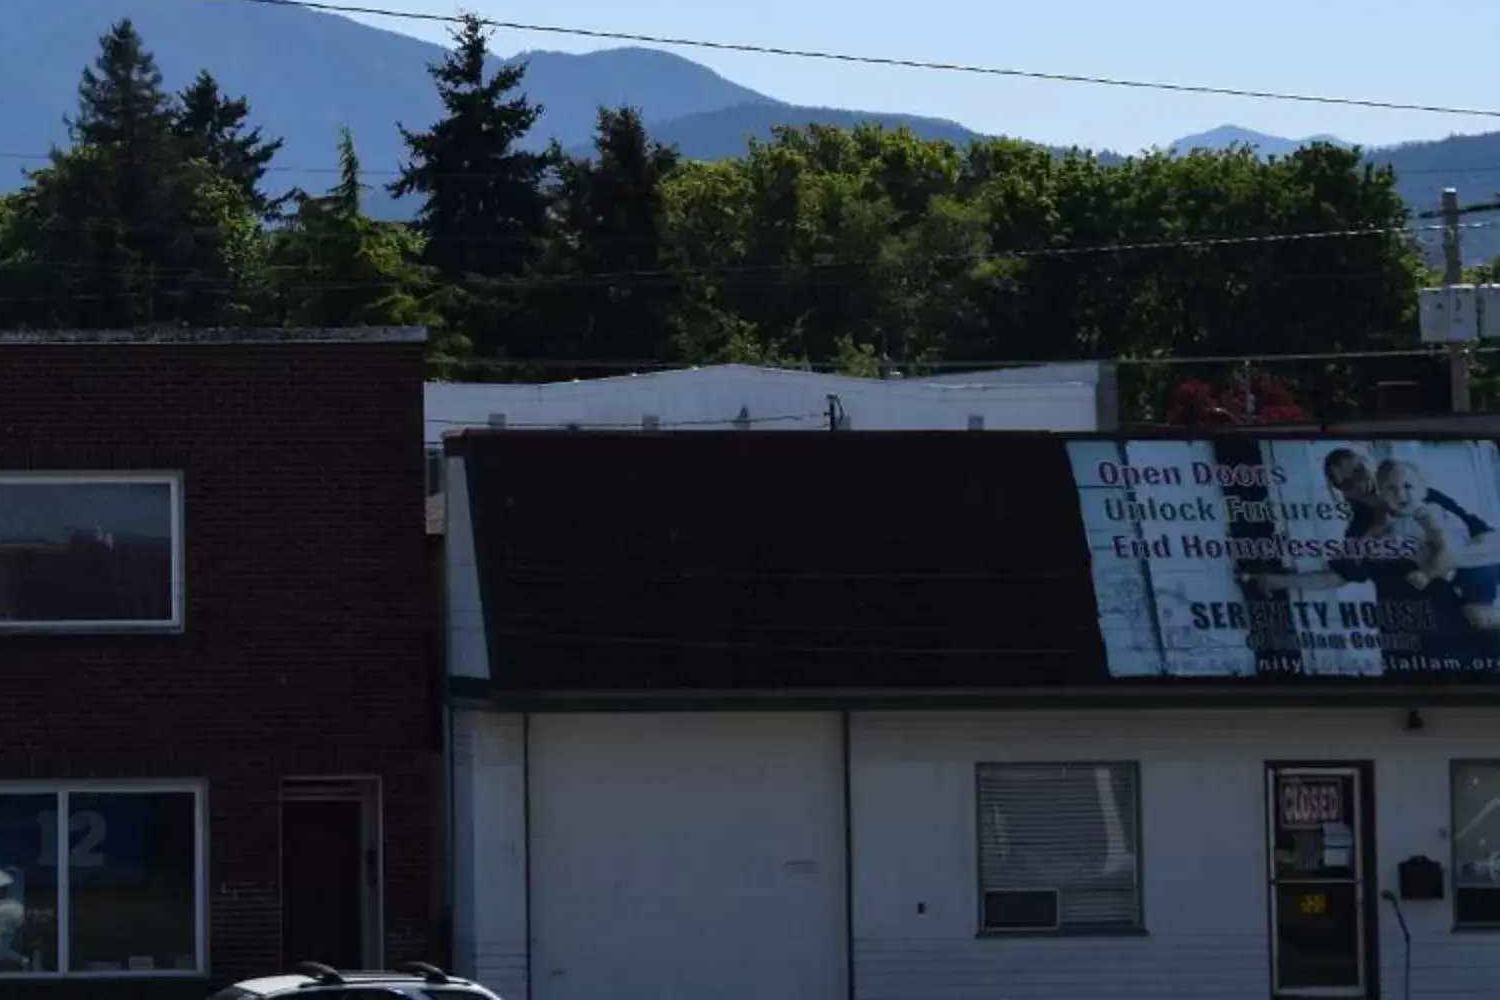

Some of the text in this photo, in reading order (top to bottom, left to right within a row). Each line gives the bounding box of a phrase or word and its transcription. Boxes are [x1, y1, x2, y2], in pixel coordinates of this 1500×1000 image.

[1098, 461, 1288, 488] Open Doors
[1104, 496, 1353, 523] Unlock Futures
[1112, 533, 1419, 561] End Homelessness
[1191, 601, 1437, 632] SERENITY HOUSE
[1283, 784, 1339, 821] CLOSED
[35, 808, 108, 868] 12
